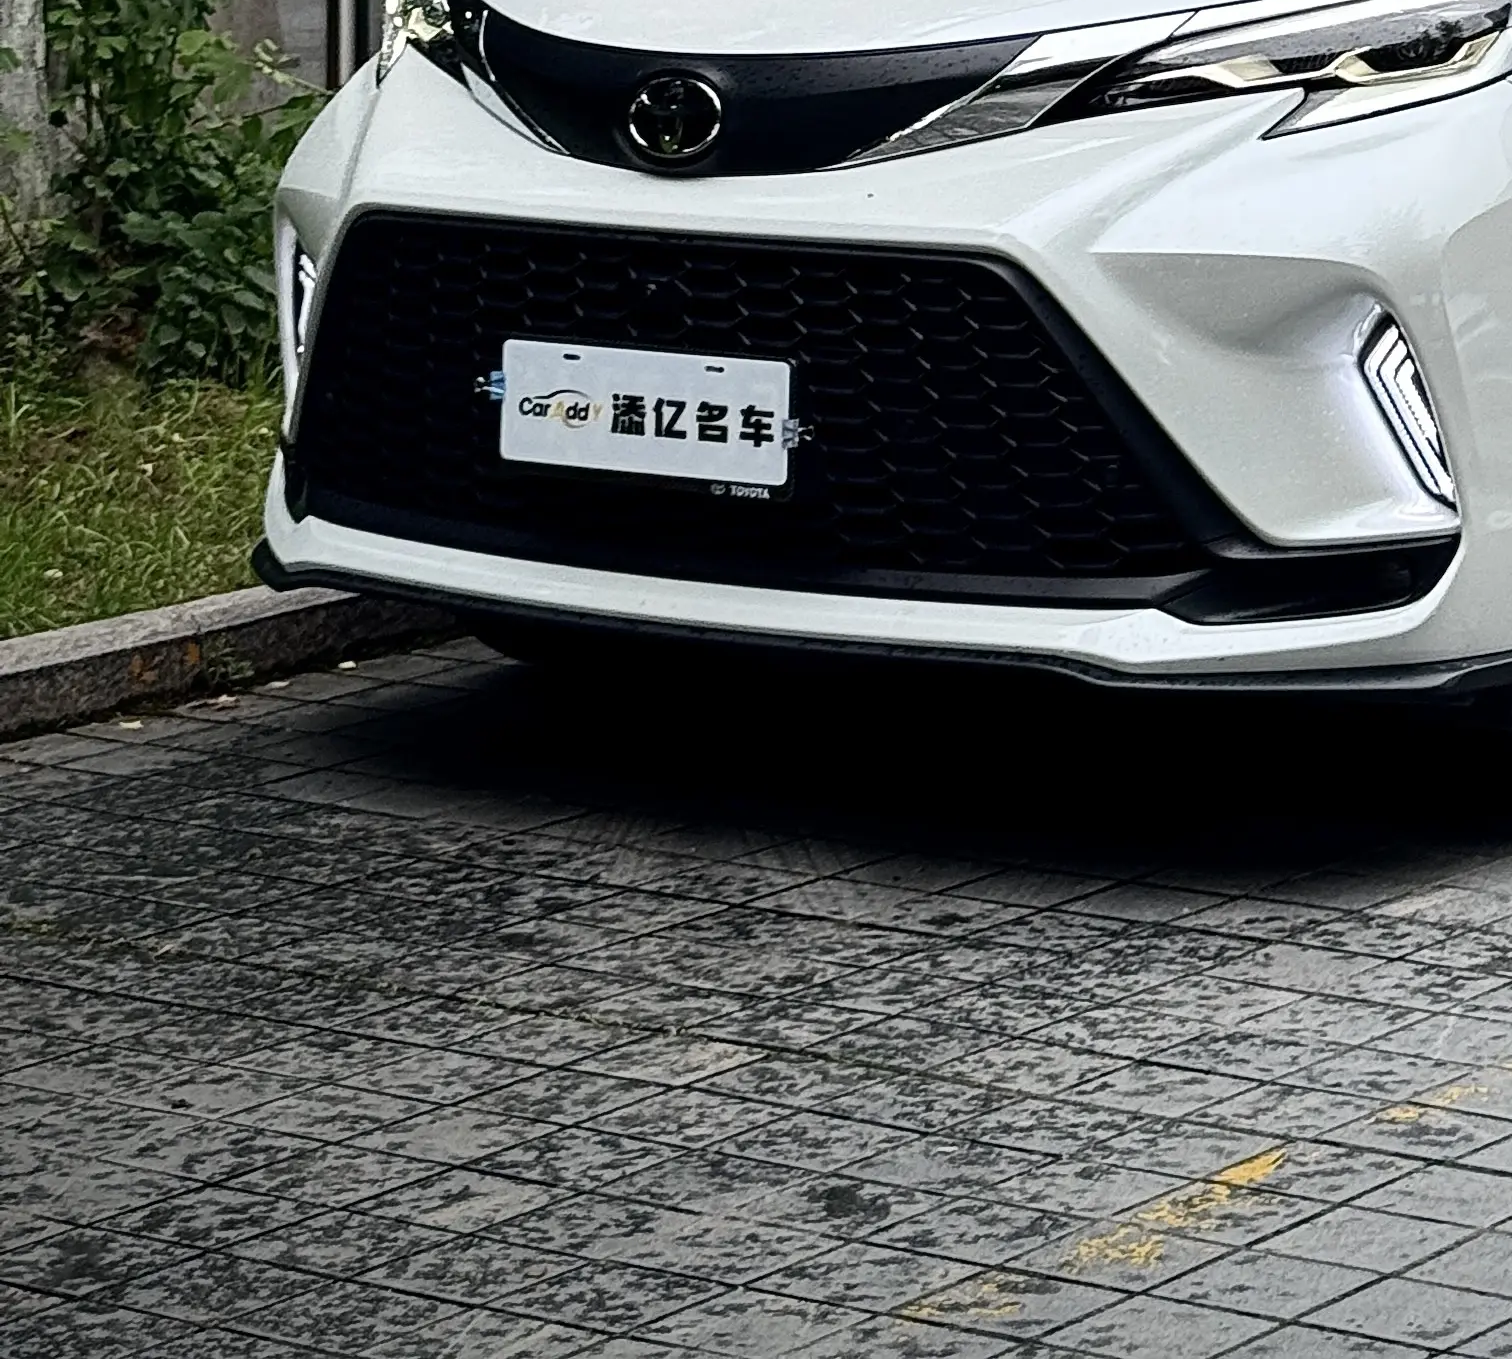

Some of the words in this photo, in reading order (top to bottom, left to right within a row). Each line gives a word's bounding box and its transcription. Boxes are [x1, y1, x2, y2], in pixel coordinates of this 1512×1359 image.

[611, 393, 775, 447] 添亿名车
[730, 484, 770, 500] TOYOTA
